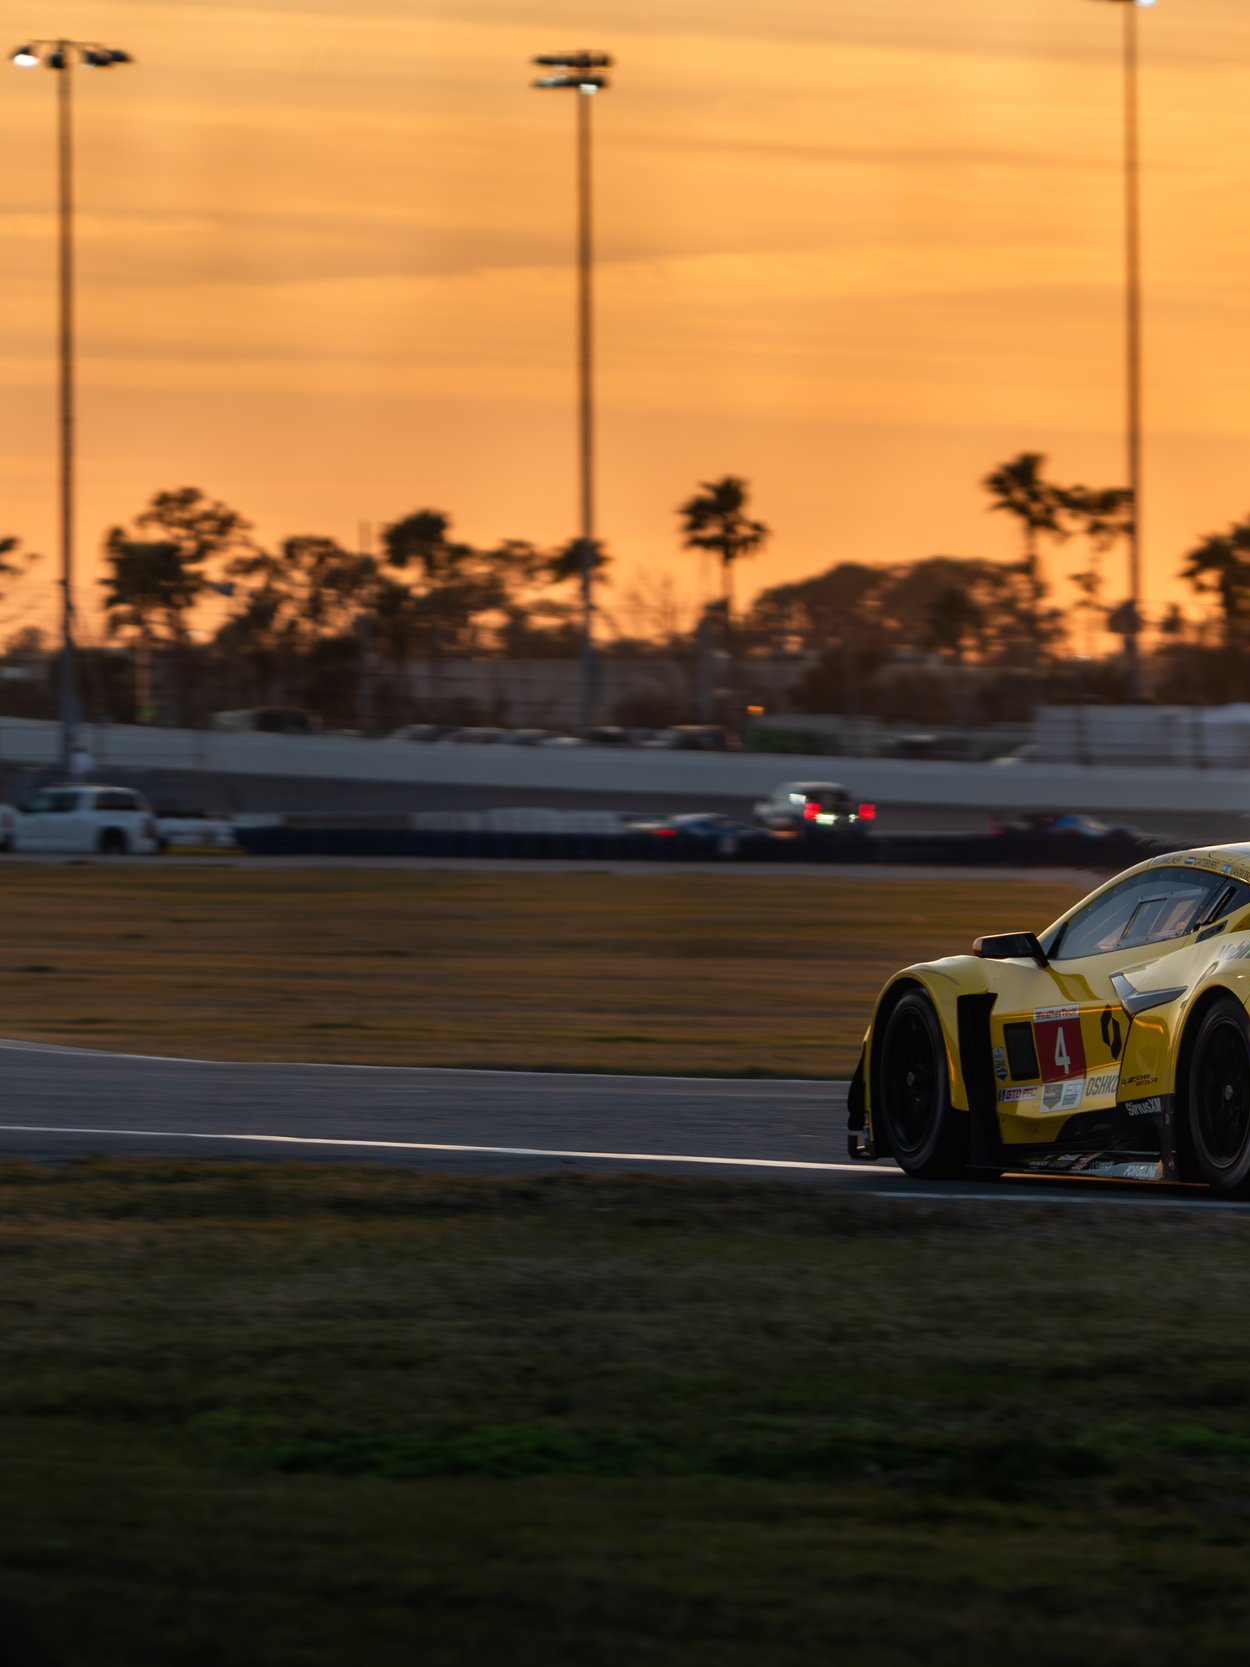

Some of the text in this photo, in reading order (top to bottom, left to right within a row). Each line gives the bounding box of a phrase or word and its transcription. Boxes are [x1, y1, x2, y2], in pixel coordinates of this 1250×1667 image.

[1054, 1026, 1071, 1075] 4
[1005, 1088, 1022, 1100] GTD
[1125, 1097, 1162, 1116] SiriusXM
